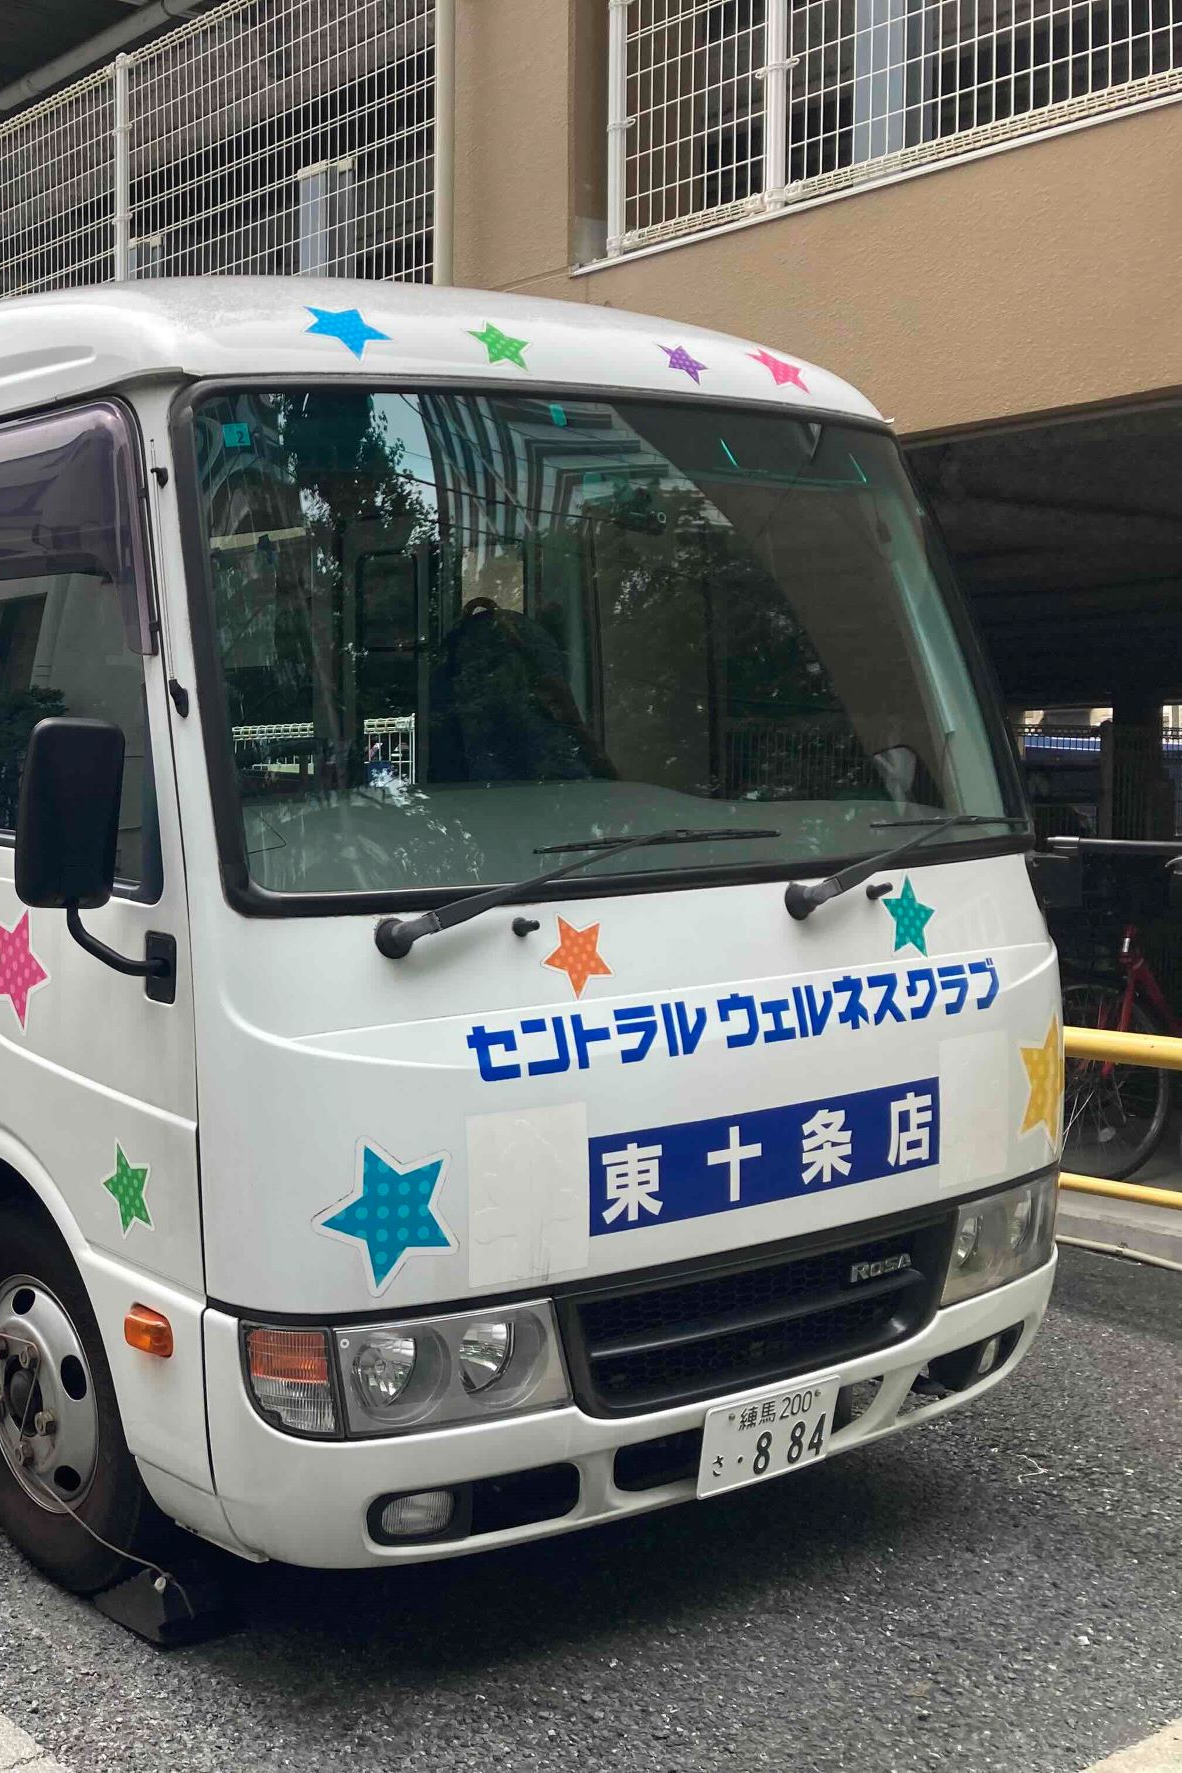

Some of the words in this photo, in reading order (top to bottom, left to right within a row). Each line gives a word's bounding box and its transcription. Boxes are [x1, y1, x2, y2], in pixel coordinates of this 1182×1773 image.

[601, 1091, 934, 1224] 東十条店
[737, 1400, 776, 1431] 練馬
[778, 1390, 813, 1421] 200
